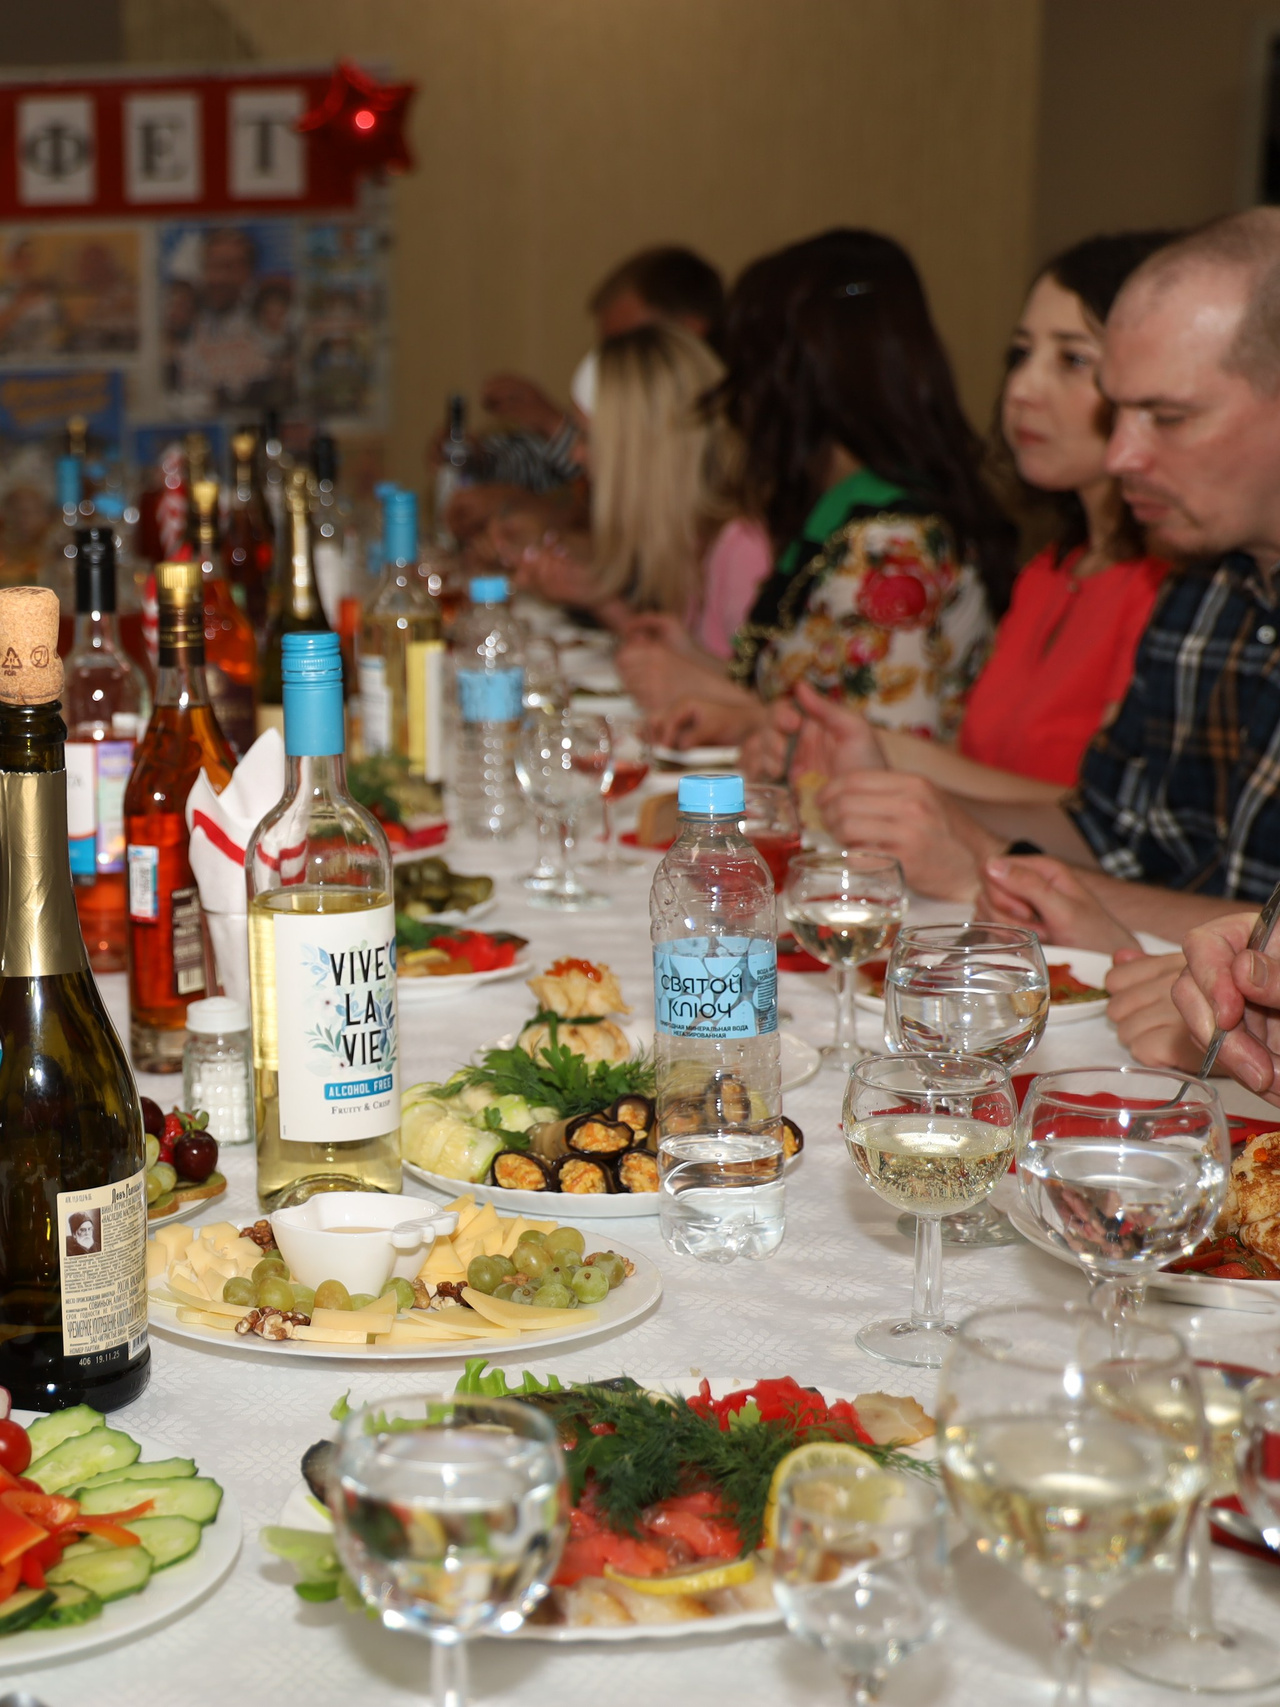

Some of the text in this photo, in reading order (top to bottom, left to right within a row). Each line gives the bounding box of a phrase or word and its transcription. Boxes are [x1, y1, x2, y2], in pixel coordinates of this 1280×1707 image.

[329, 946, 386, 986] VIVE
[661, 974, 743, 994] СВЯТОЙ
[345, 990, 377, 1026] LA
[669, 1000, 731, 1022] КЛЮЧ
[673, 1030, 727, 1038] НЕГАЗИРОВАННАЯ
[342, 1030, 382, 1067] VIE
[328, 1077, 391, 1097] ALCOHOL FREE
[364, 1103, 371, 1112] &
[95, 1350, 120, 1364] 19.11.25
